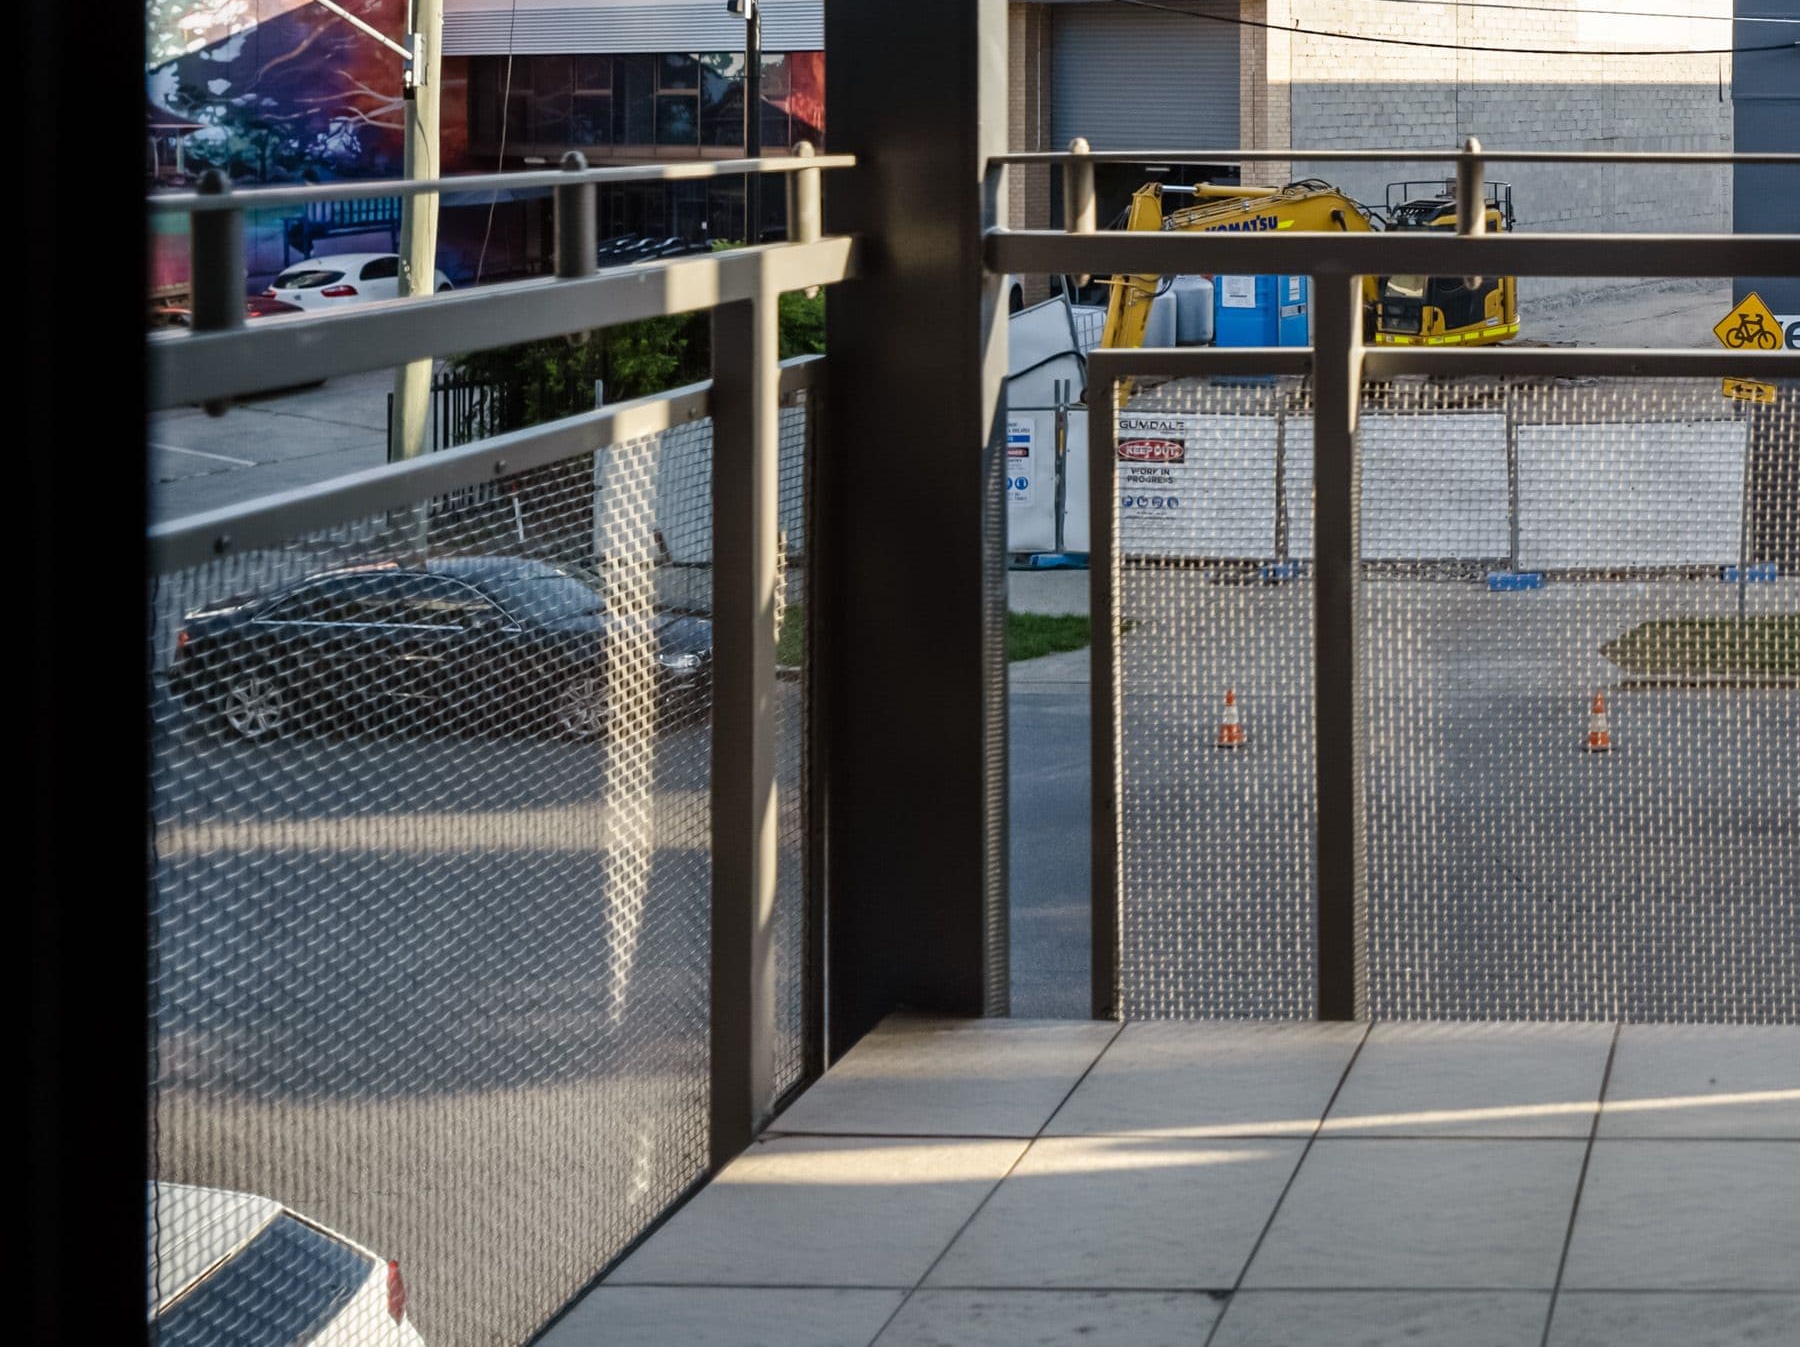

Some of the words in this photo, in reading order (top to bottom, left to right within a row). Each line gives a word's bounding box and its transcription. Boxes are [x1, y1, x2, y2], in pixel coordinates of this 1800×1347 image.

[1126, 445, 1153, 455] KEEP
[1131, 467, 1158, 475] WORK
[1161, 467, 1170, 475] IN
[1127, 475, 1174, 484] PROGRESS
